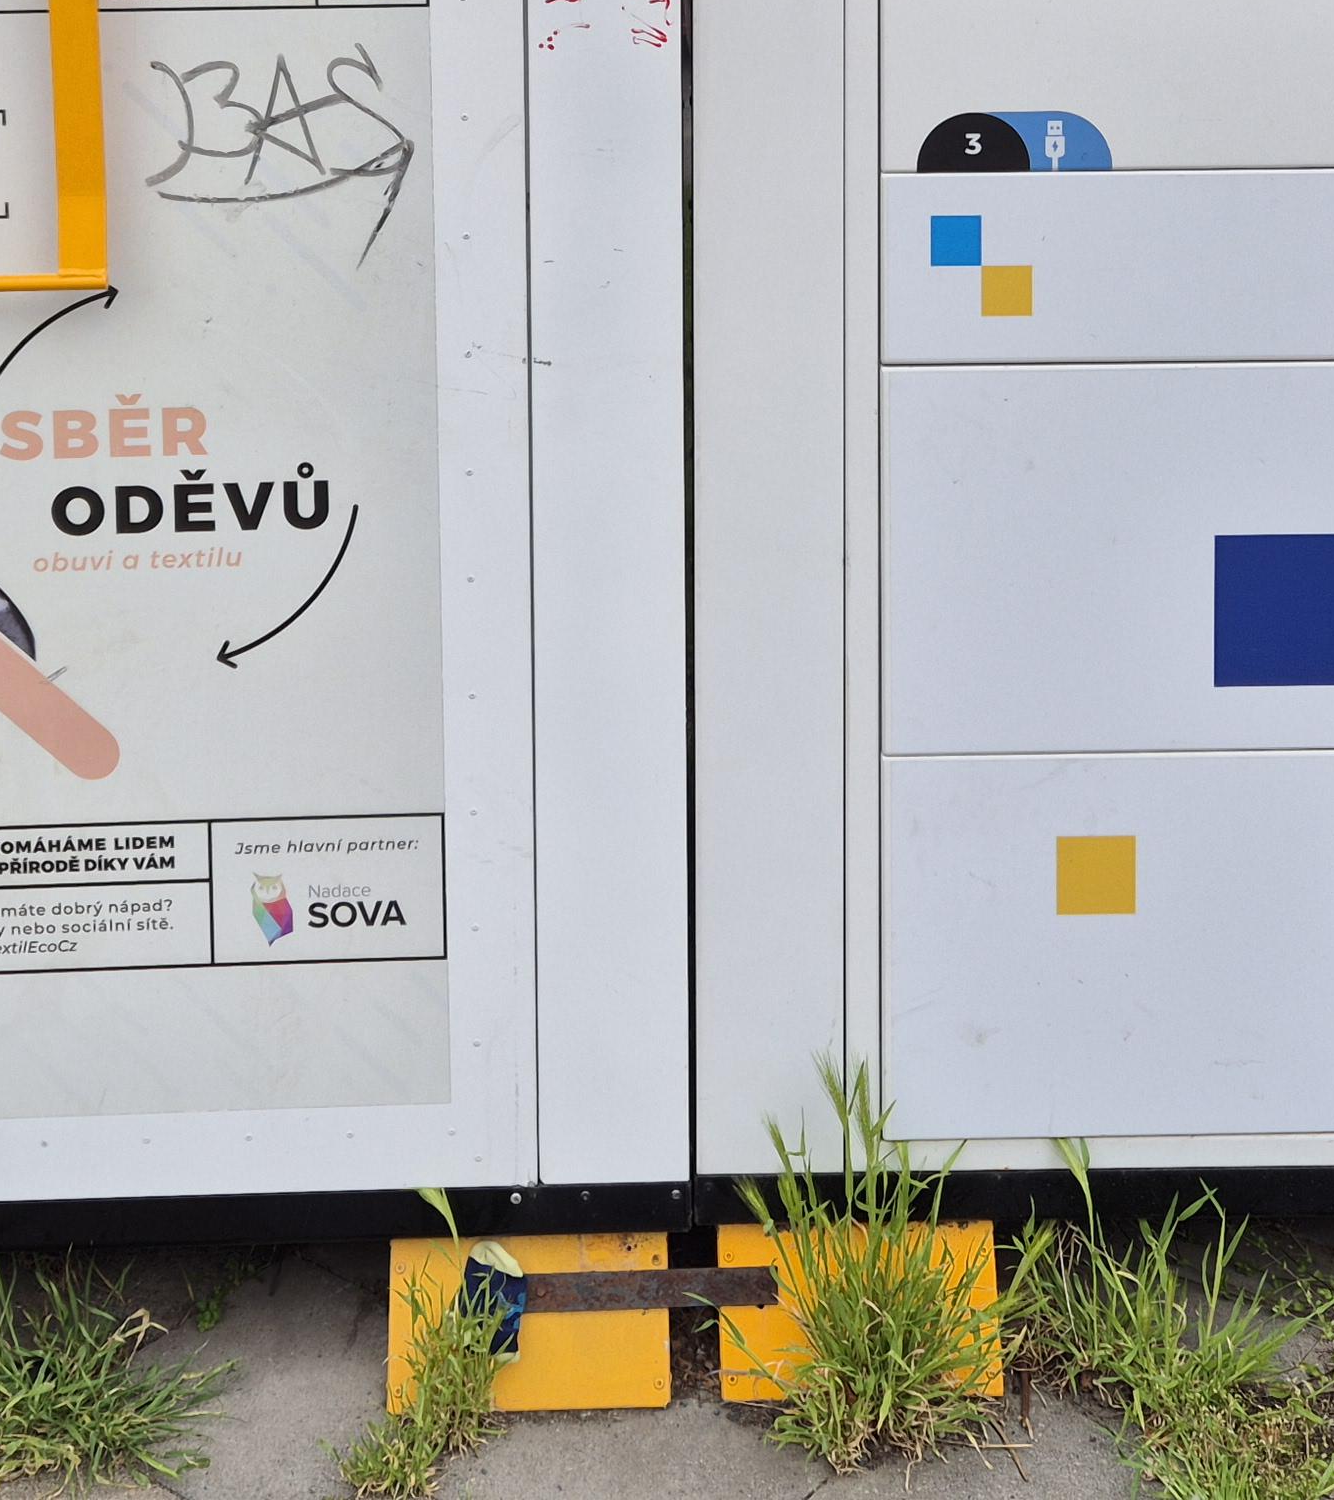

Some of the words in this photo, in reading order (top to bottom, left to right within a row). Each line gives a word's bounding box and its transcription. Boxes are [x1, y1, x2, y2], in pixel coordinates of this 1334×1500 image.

[964, 133, 982, 155] 3
[51, 461, 330, 537] ODĚVŮ
[32, 550, 113, 573] obuvi
[122, 554, 140, 570] a
[150, 547, 244, 569] textilu
[113, 835, 175, 851] LIDEM
[234, 841, 282, 855] Jsme
[286, 838, 342, 854] hlavní
[346, 836, 420, 855] partner:
[83, 854, 129, 872] DÍKY
[132, 852, 175, 870] VÁM
[307, 882, 372, 899] Nadace
[0, 902, 46, 917] máte
[51, 900, 103, 917] dobrý
[108, 898, 173, 915] nápad?
[307, 899, 407, 929] SOVA
[11, 921, 56, 936] nebo
[61, 918, 131, 934] sociální
[136, 916, 174, 931] sítě.
